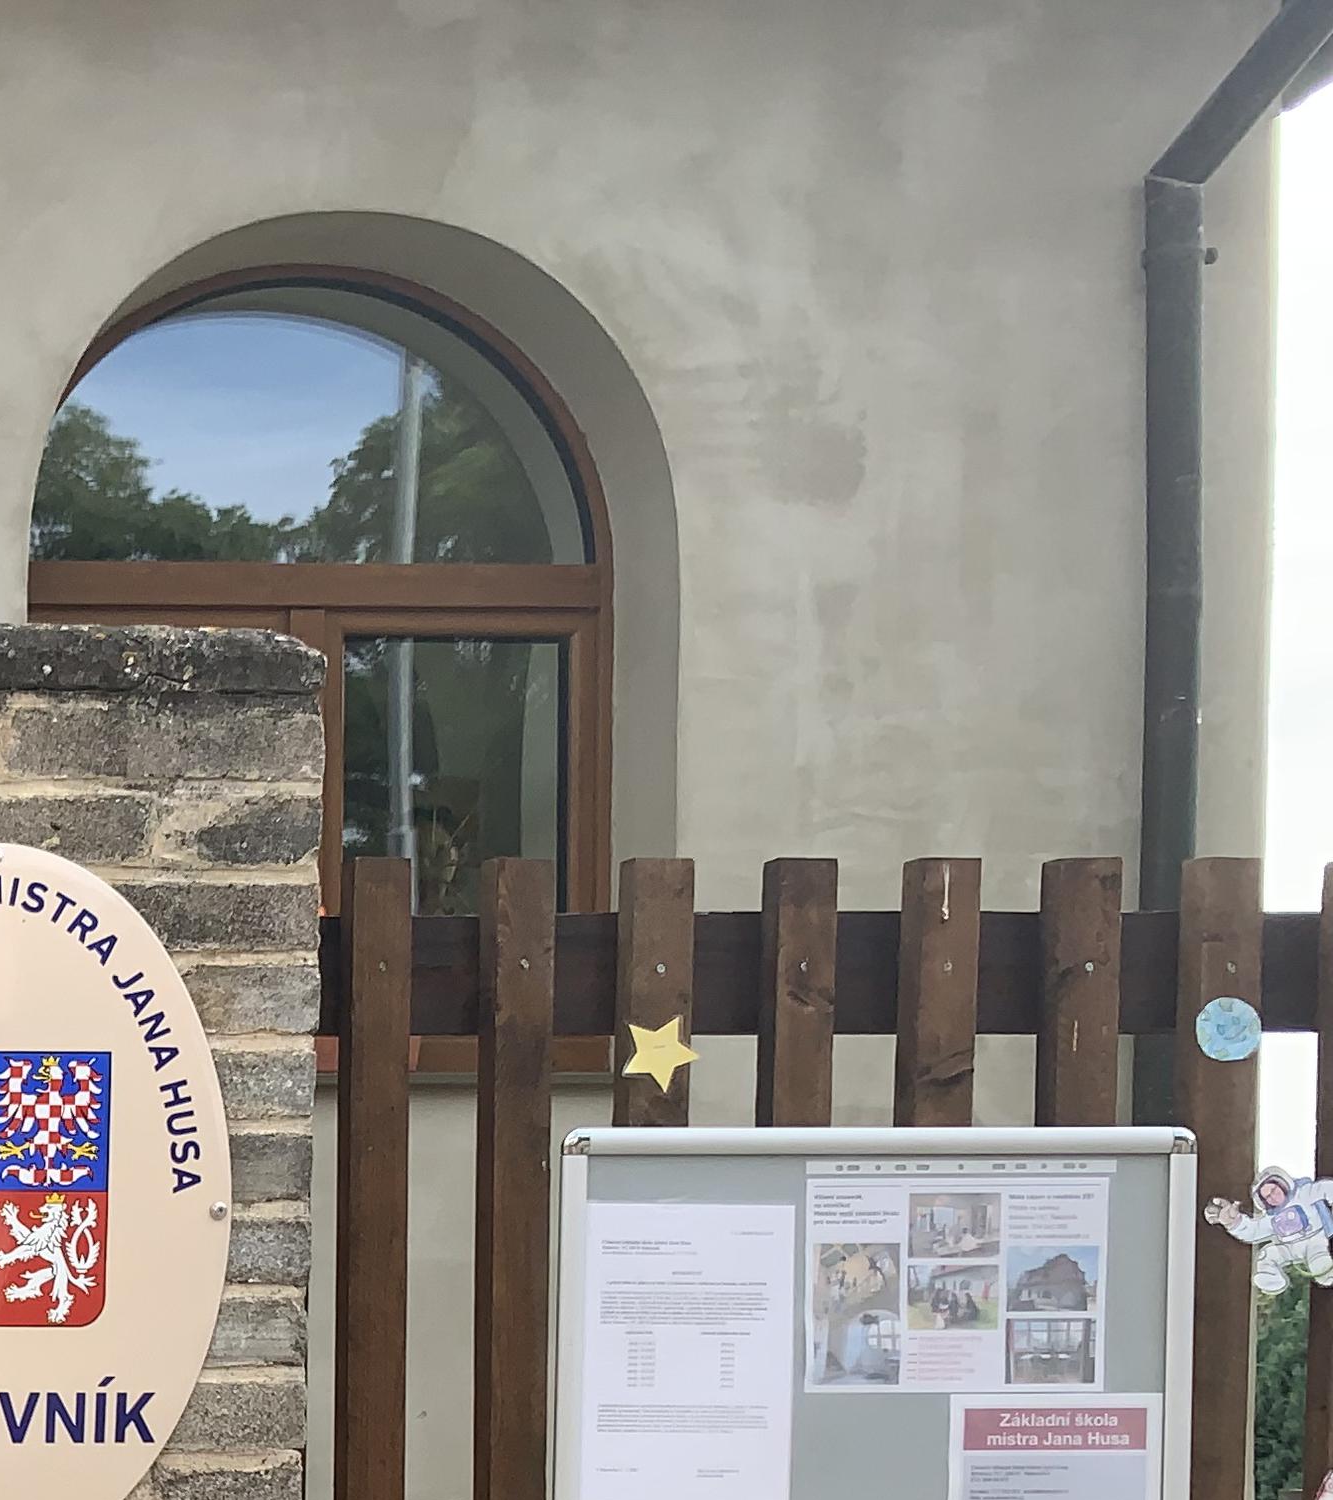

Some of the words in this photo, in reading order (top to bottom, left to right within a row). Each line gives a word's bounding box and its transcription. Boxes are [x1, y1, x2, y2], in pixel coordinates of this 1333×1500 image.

[112, 971, 180, 1072] JANA
[159, 1078, 201, 1195] HUSA
[999, 1412, 1070, 1427] Základní
[1075, 1412, 1118, 1427] škola
[986, 1432, 1038, 1446] mistra
[1043, 1432, 1082, 1446] Jana
[1087, 1432, 1130, 1446] Husa
